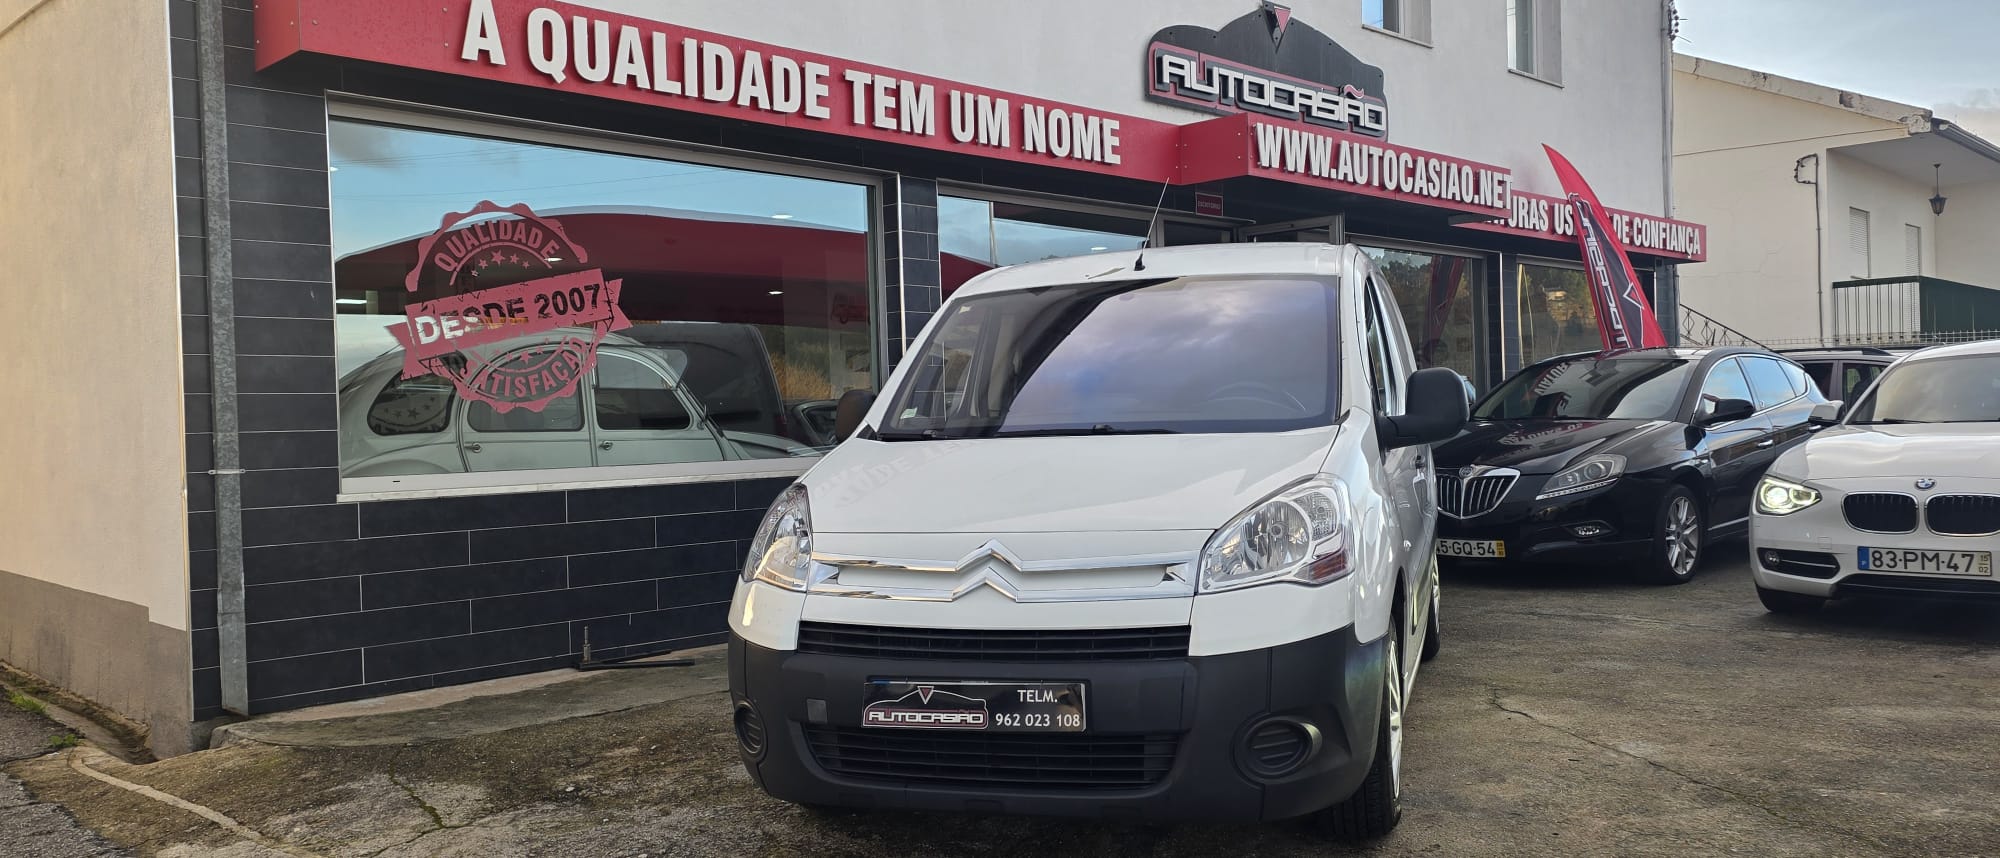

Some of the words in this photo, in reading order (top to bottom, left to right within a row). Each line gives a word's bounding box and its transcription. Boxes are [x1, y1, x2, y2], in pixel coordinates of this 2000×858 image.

[461, 0, 506, 65] A
[527, 8, 831, 120] QUALIDADE
[844, 69, 935, 136] TEM
[949, 89, 1011, 148] UM
[1024, 103, 1121, 165] NOME
[1162, 54, 1386, 131] AUTOCASIÃO
[1255, 122, 1513, 210] WWW.AUTOCASIAO.NET
[434, 219, 561, 272] QUALIDADE
[1633, 217, 1701, 259] CONFIANÇA
[415, 297, 528, 345] DESDE
[534, 284, 601, 319] 2007
[995, 713, 1021, 727] 962
[1025, 713, 1051, 727] 023
[1056, 714, 1081, 728] 108
[1017, 689, 1058, 703] TELM.
